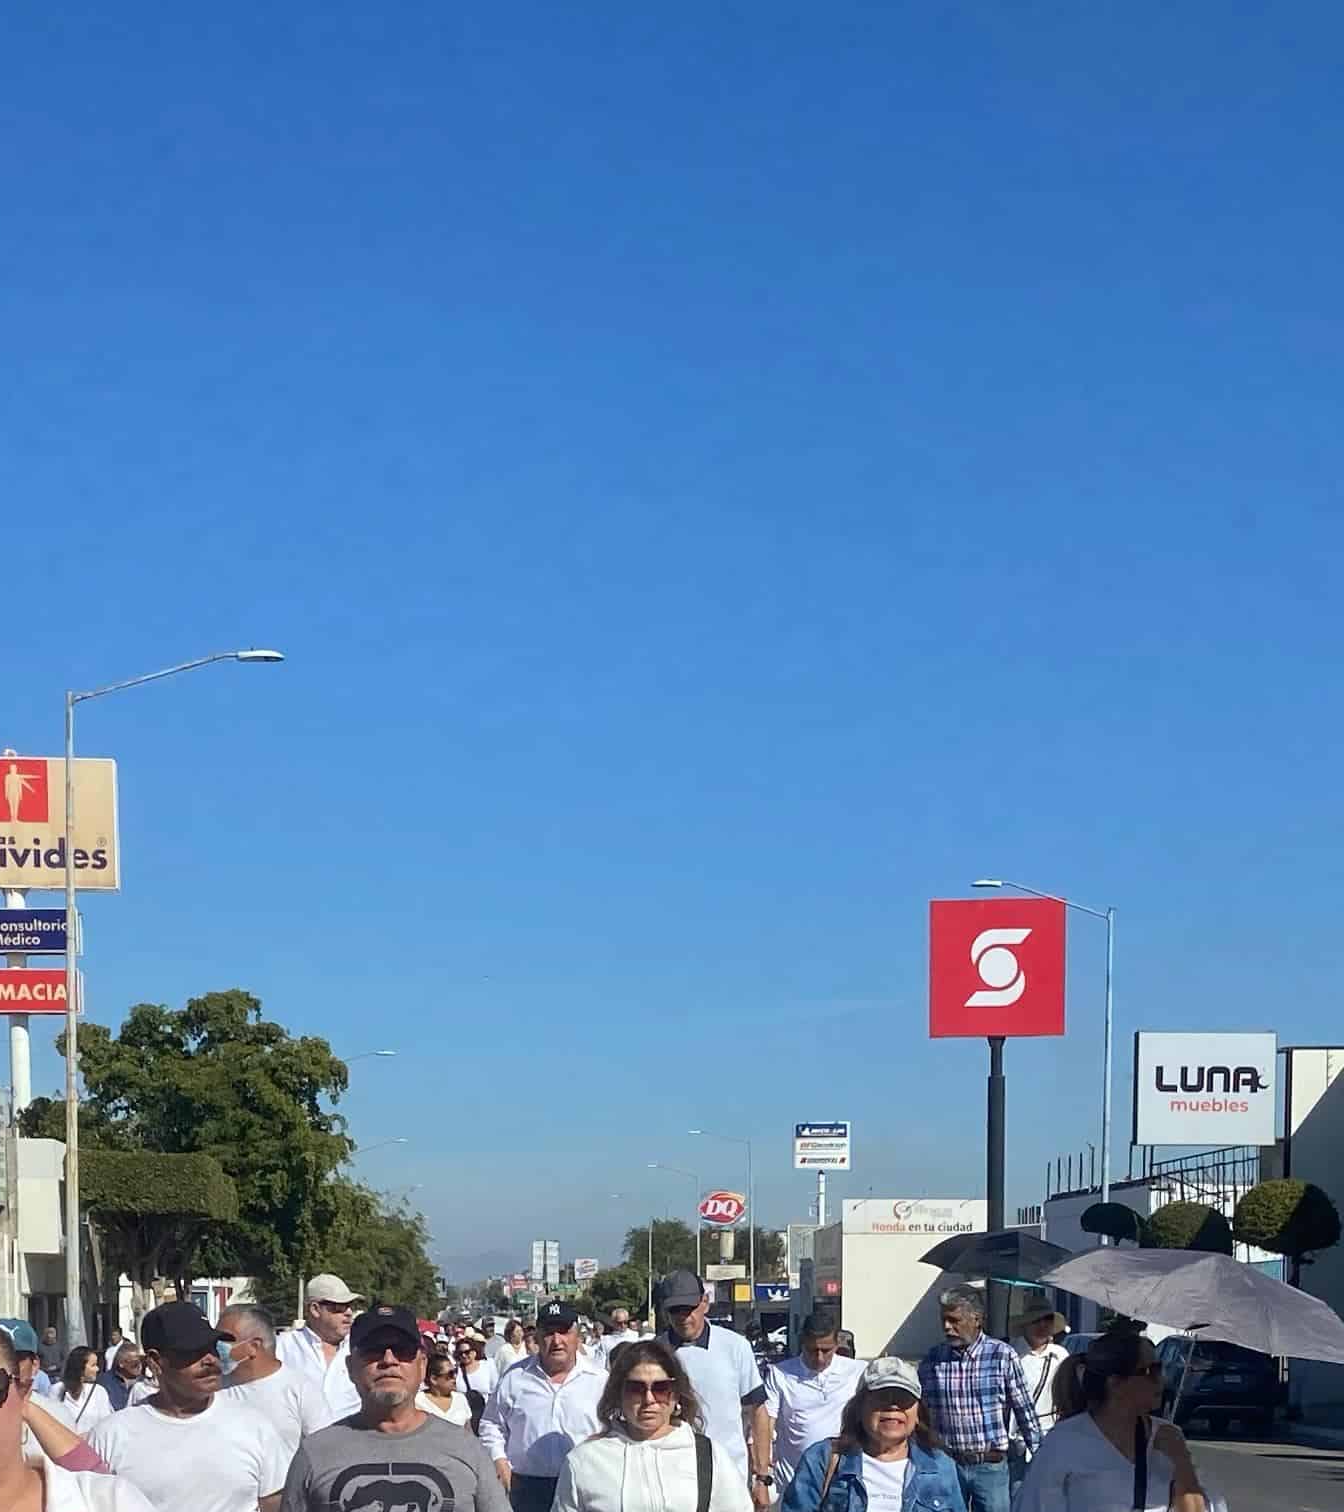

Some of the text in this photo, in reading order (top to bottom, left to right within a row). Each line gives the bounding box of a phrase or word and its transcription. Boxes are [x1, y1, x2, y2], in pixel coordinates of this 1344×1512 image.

[1156, 1066, 1258, 1093] LUNA
[1170, 1099, 1249, 1113] muebles
[706, 1200, 738, 1217] DQ
[938, 1222, 973, 1232] ciudad
